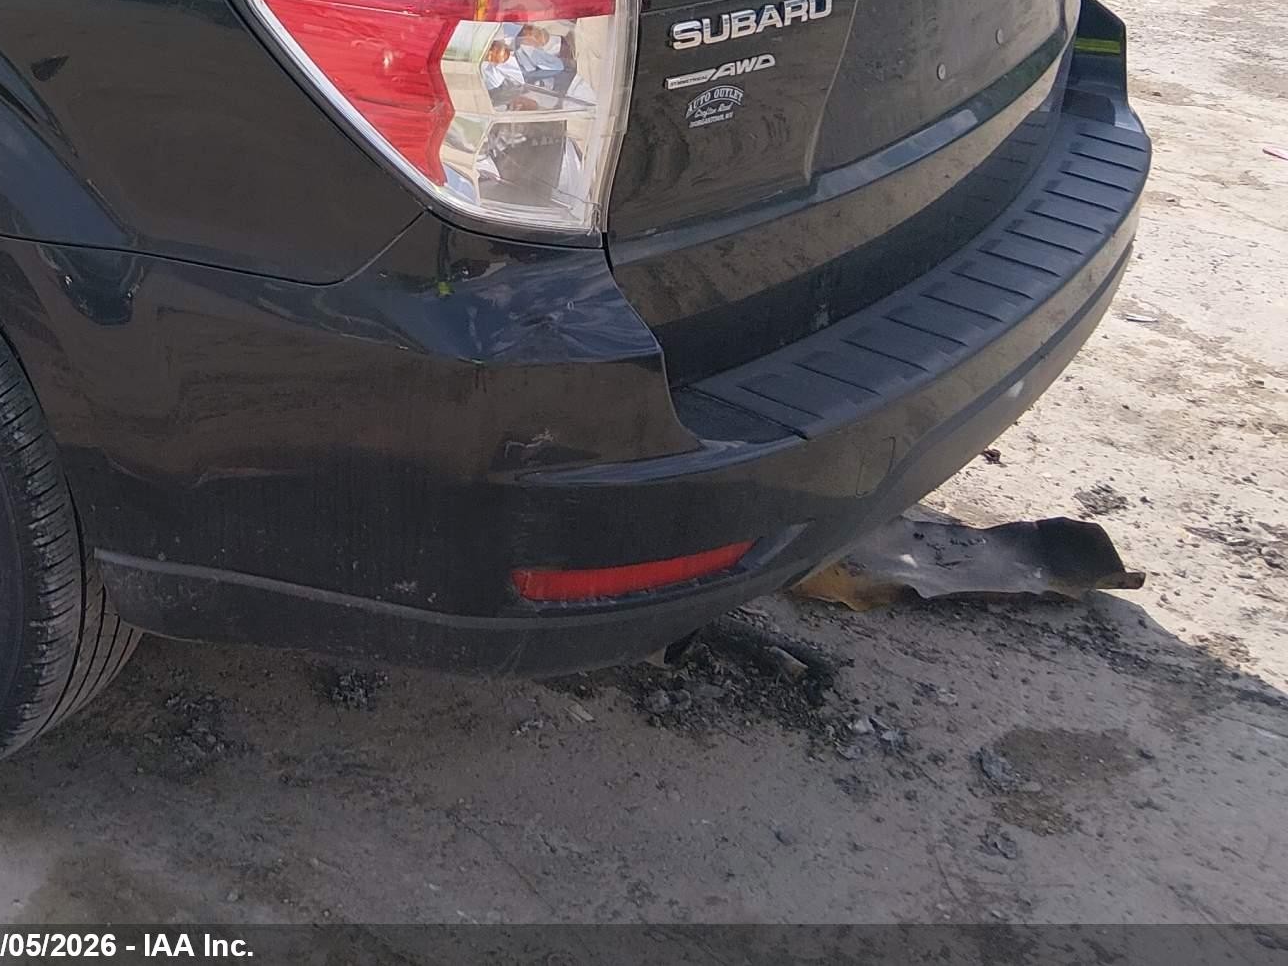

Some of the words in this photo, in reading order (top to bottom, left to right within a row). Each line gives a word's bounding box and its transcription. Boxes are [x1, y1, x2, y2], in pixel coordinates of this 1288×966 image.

[710, 54, 776, 81] AWD
[686, 92, 711, 118] AUTO
[713, 88, 744, 102] OUTLET
